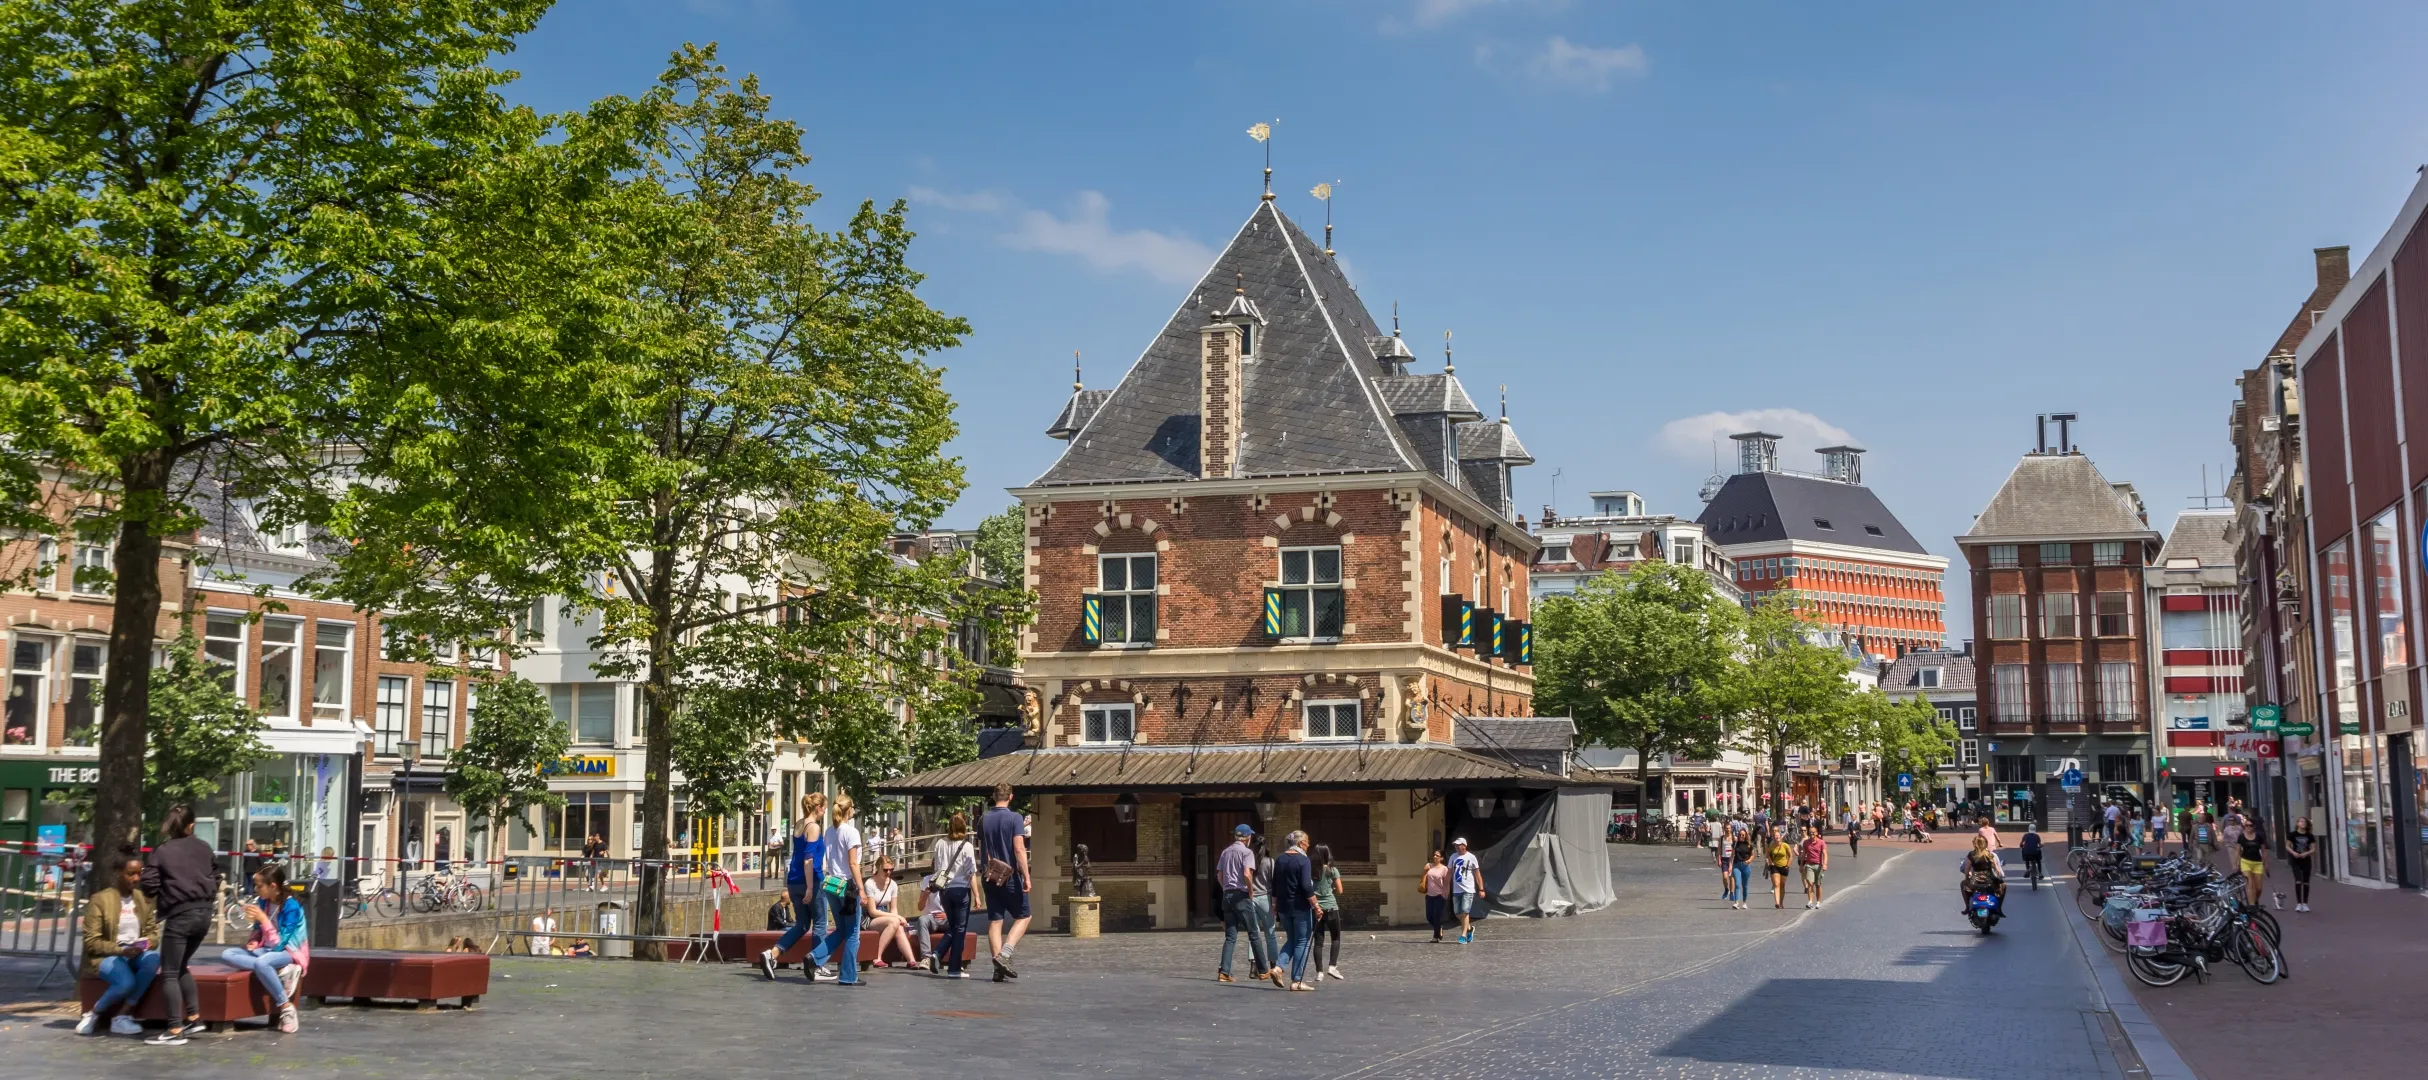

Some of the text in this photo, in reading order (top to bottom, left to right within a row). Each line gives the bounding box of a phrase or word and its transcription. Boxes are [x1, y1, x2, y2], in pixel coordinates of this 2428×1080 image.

[2037, 413, 2078, 454] IT
[2386, 700, 2408, 718] ZARA
[2255, 718, 2278, 727] PEARLE
[2279, 725, 2312, 733] Specsavers
[48, 767, 100, 783] THE BO
[2219, 767, 2249, 776] SP
